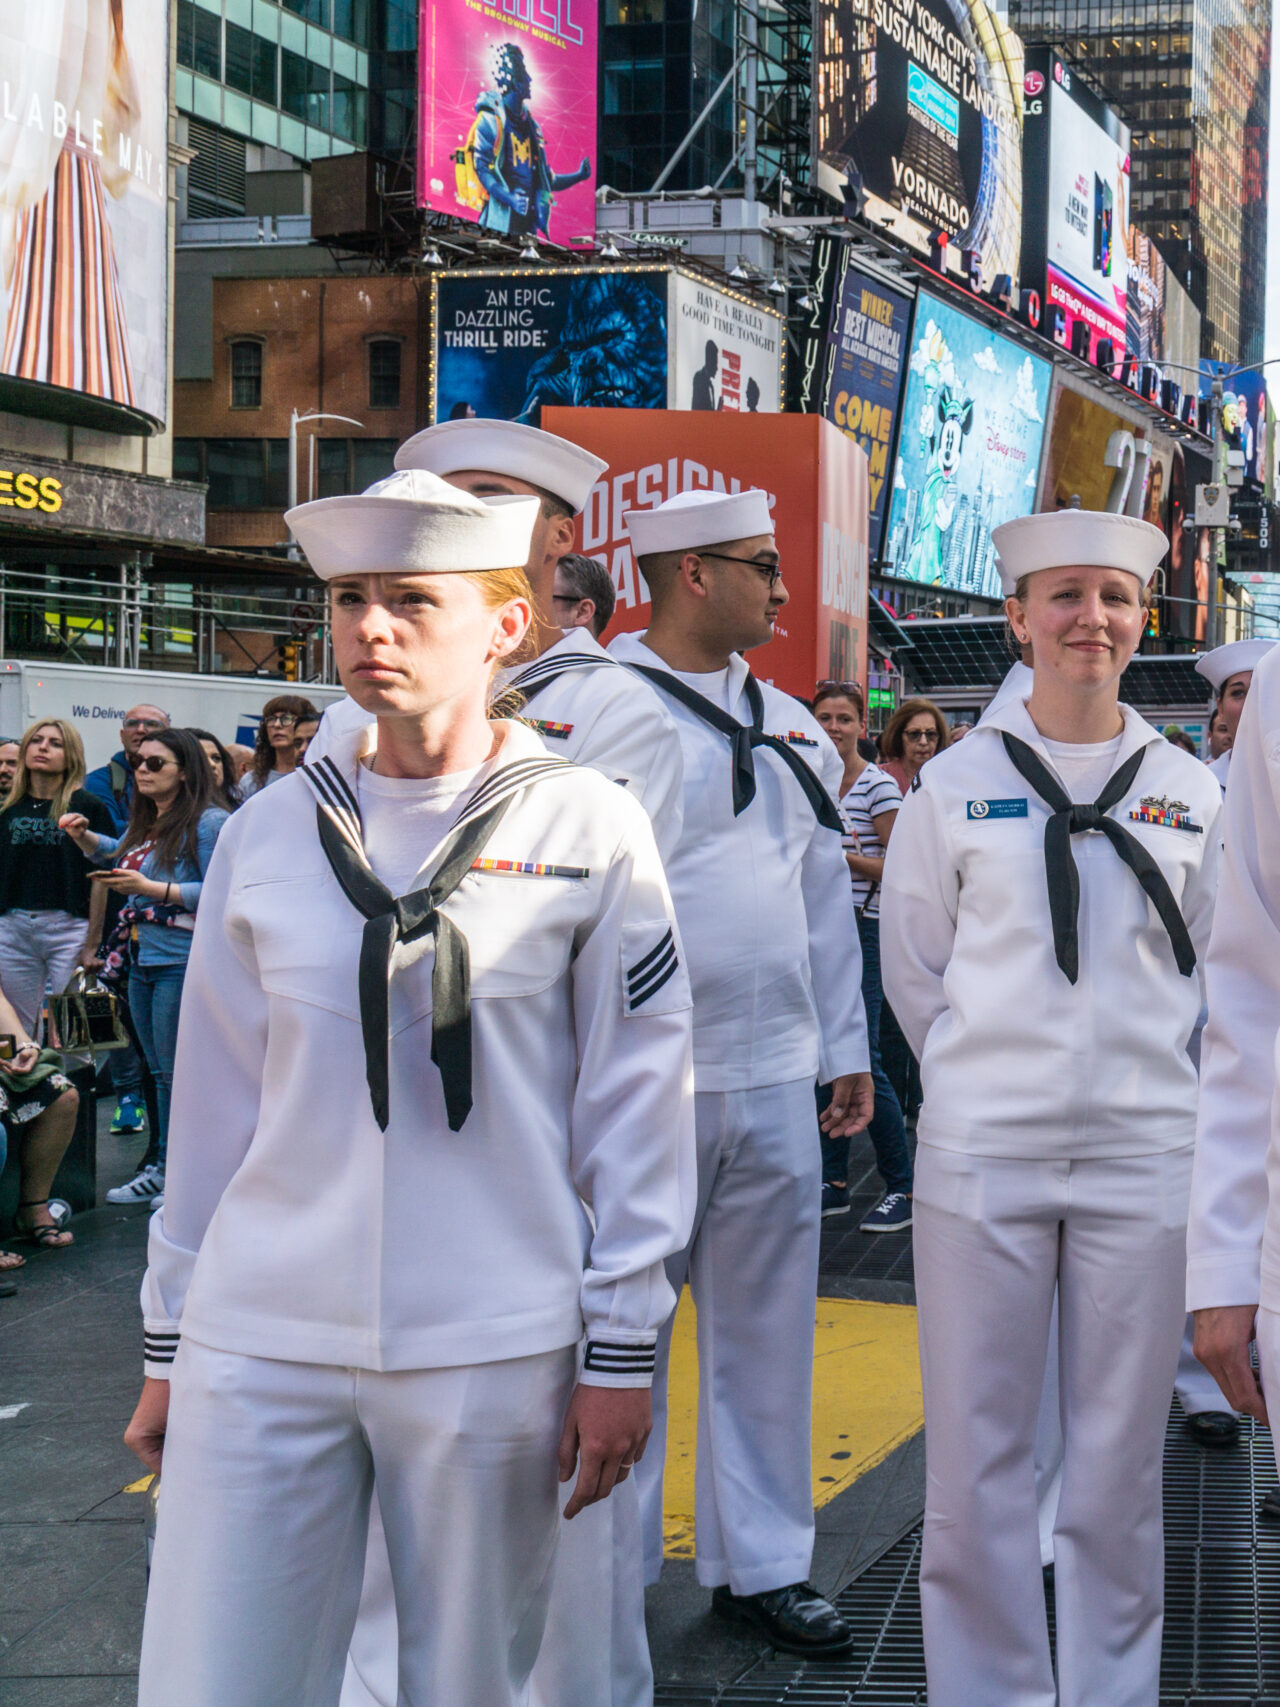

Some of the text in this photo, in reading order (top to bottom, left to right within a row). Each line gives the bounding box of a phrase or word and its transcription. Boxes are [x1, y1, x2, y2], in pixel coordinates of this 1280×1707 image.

[484, 6, 529, 33] BROADWAY
[531, 26, 567, 50] MUSICAL
[916, 2, 945, 48] YORK
[946, 32, 976, 74] CITY'S
[874, 0, 1021, 141] SUSTAINABLE LANDLORD
[1061, 69, 1071, 91] LG
[1022, 101, 1043, 115] LG
[119, 132, 152, 184] MAY
[891, 155, 970, 230] VORNADO
[903, 196, 958, 238] REALTY TRUST
[634, 233, 684, 247] LAMAR
[455, 309, 534, 327] DAZZLING
[514, 288, 555, 307] EPIC,
[697, 291, 764, 331] HAVE A REALLY
[444, 330, 498, 347] THRILL
[682, 303, 776, 353] GOOD TIME TONIGHT
[844, 307, 900, 360] BEST MUSICAL
[721, 349, 741, 412] PRE
[834, 390, 893, 444] COME
[986, 426, 1026, 463] Disney store
[1104, 430, 1153, 519] 21
[1259, 507, 1268, 548] 1500
[822, 521, 866, 620] DESIGN
[72, 705, 126, 720] We Delive
